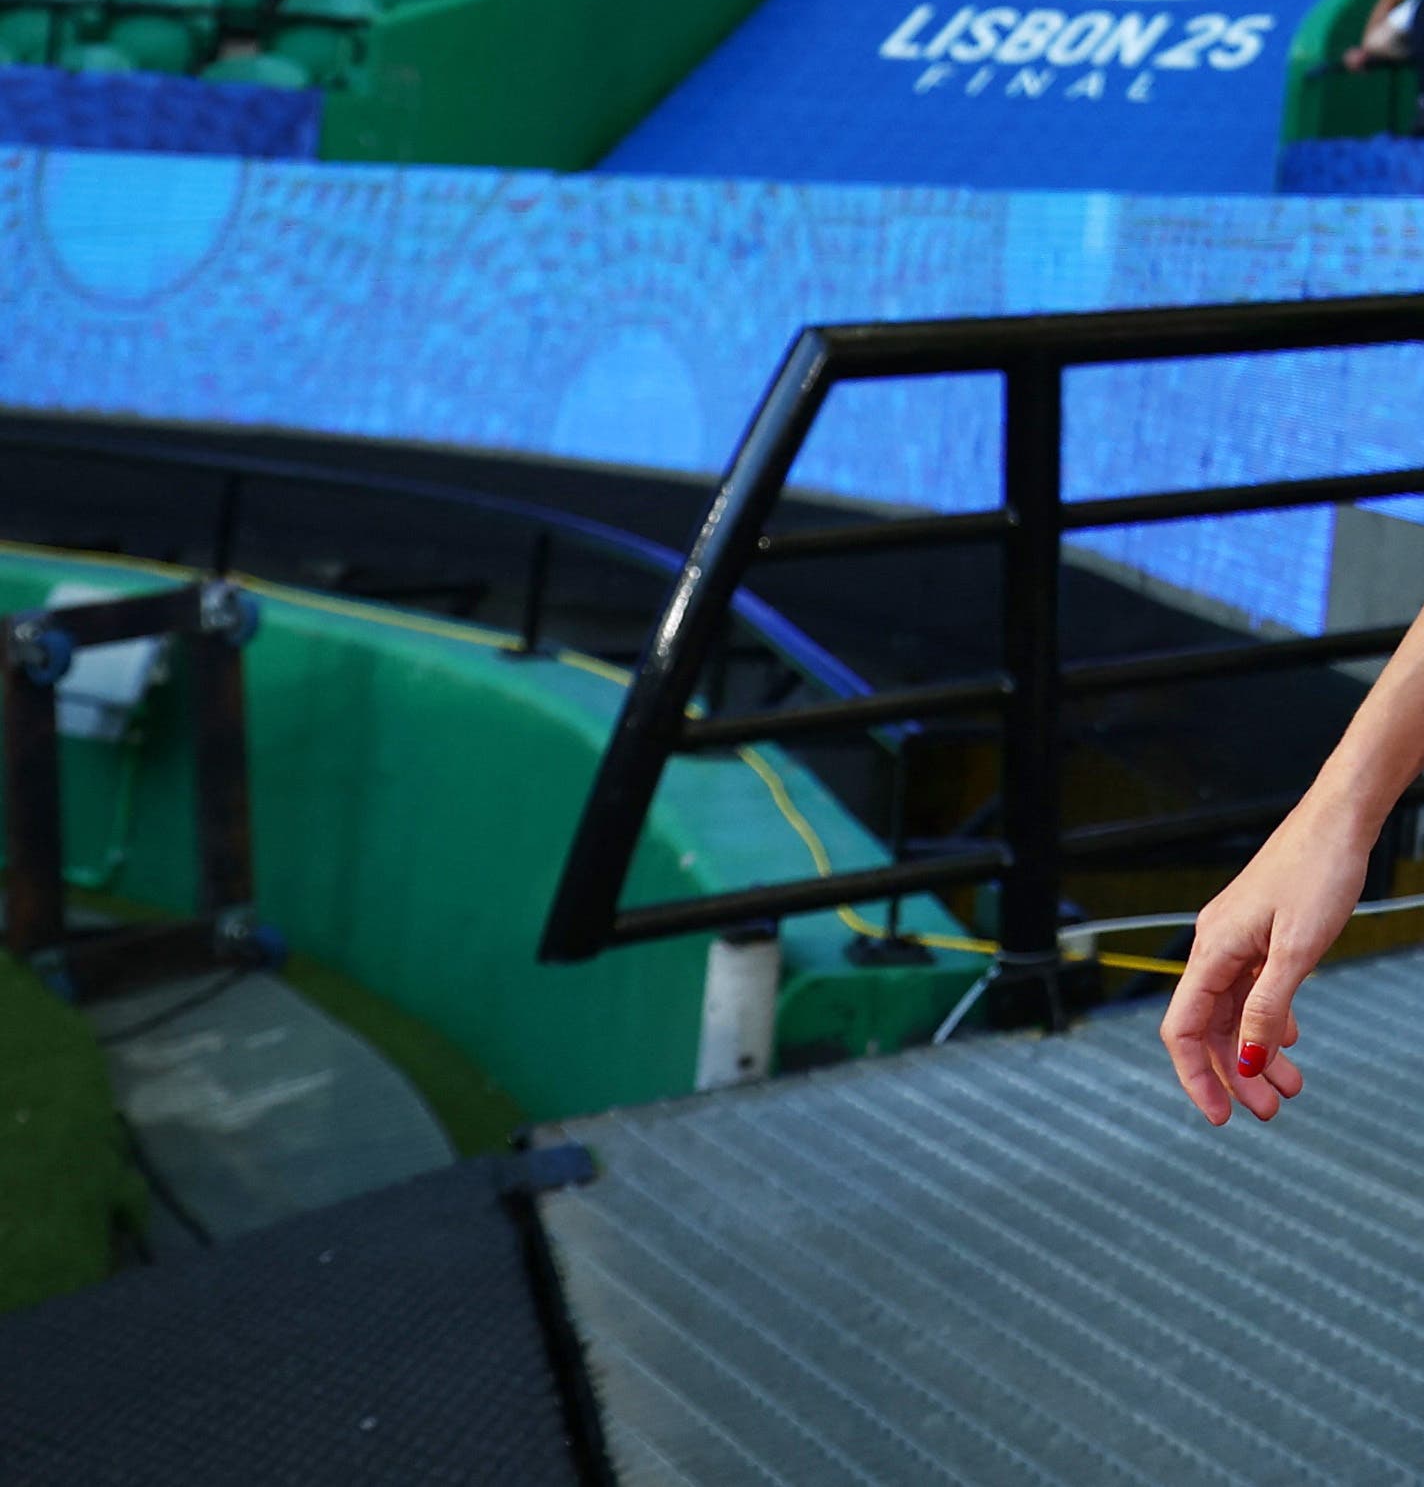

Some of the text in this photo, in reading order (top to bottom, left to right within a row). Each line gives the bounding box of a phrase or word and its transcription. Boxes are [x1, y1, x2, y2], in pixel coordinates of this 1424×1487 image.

[878, 3, 1276, 70] LISBON 25
[912, 63, 1156, 102] FINAL
